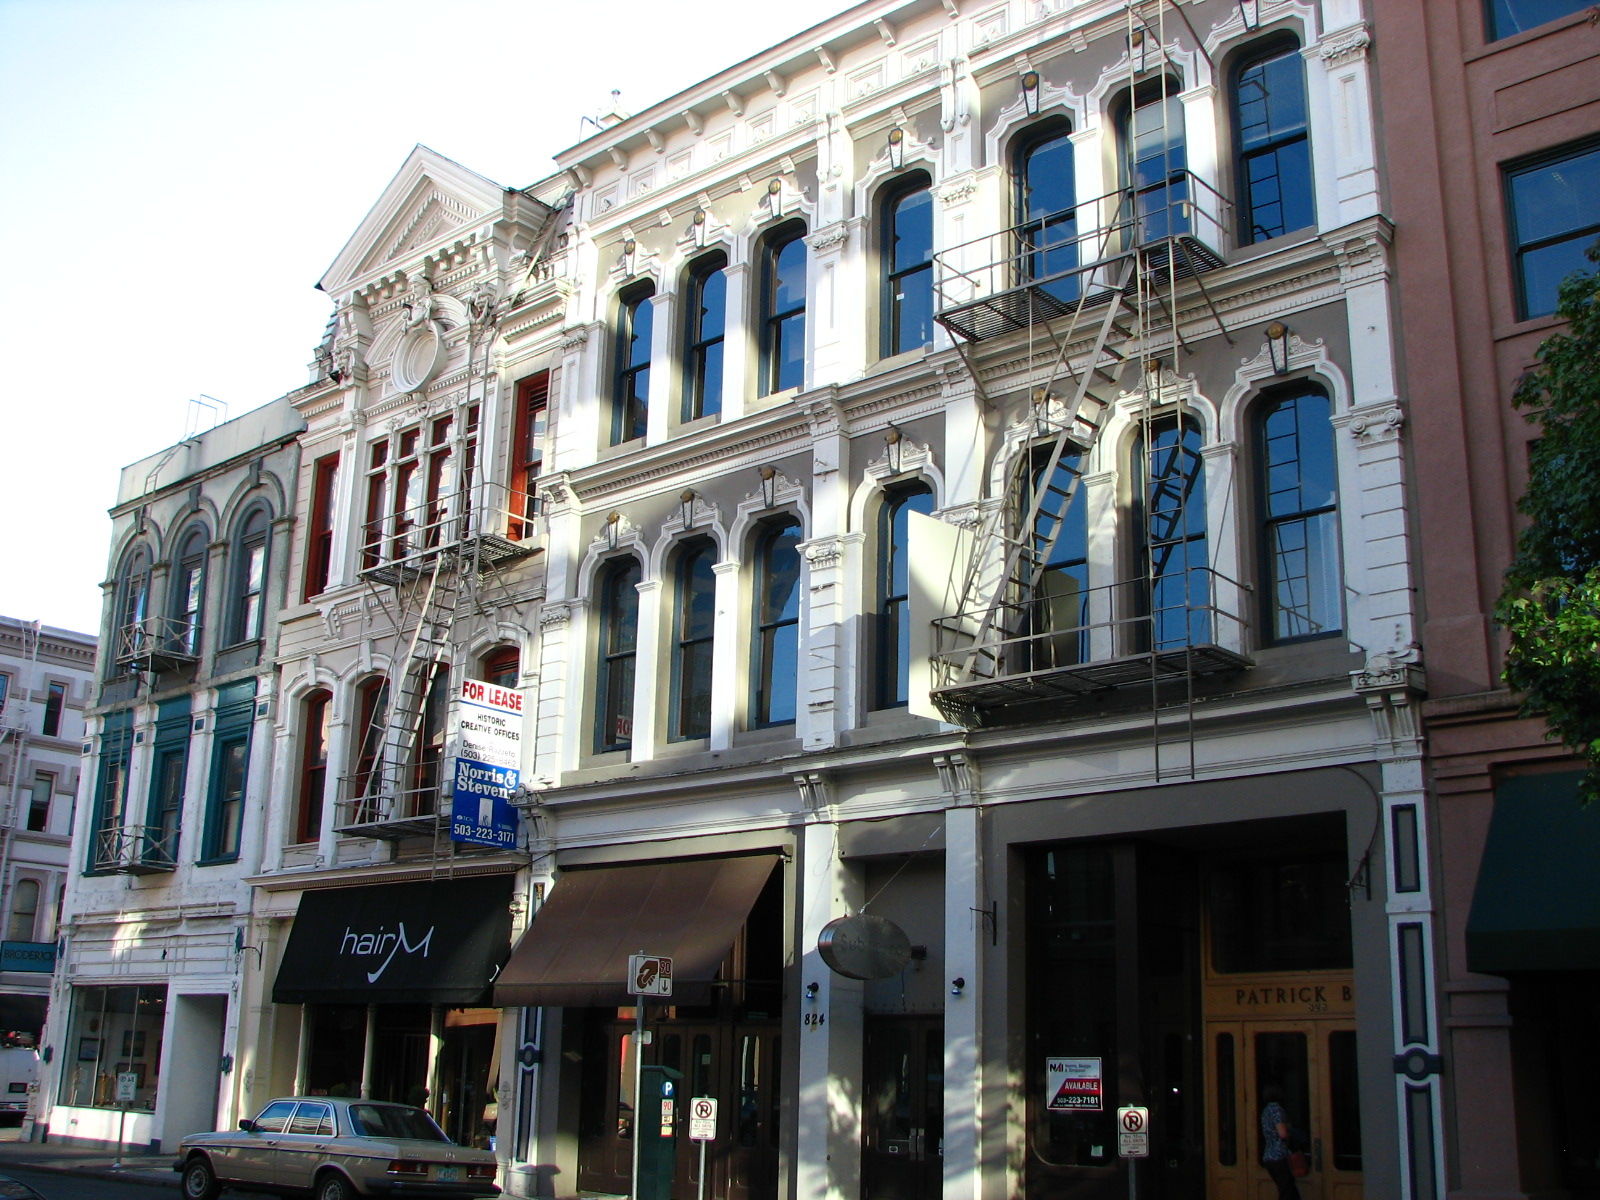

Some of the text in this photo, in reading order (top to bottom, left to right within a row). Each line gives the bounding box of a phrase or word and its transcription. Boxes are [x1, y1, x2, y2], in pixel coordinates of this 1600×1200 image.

[463, 681, 522, 711] FOR LEASE
[478, 713, 506, 727] HISTORIC
[461, 720, 520, 741] CREATIVE OFFICES
[461, 749, 480, 761] (503)
[458, 761, 517, 789] Norris &
[454, 824, 514, 843] 503-223-3171
[660, 960, 671, 975] 90
[1235, 986, 1328, 1006] PATRICK
[804, 1013, 826, 1026] 824
[1049, 1062, 1064, 1072] NAI
[1064, 1081, 1098, 1090] AVAILABLE
[663, 1101, 672, 1111] 90
